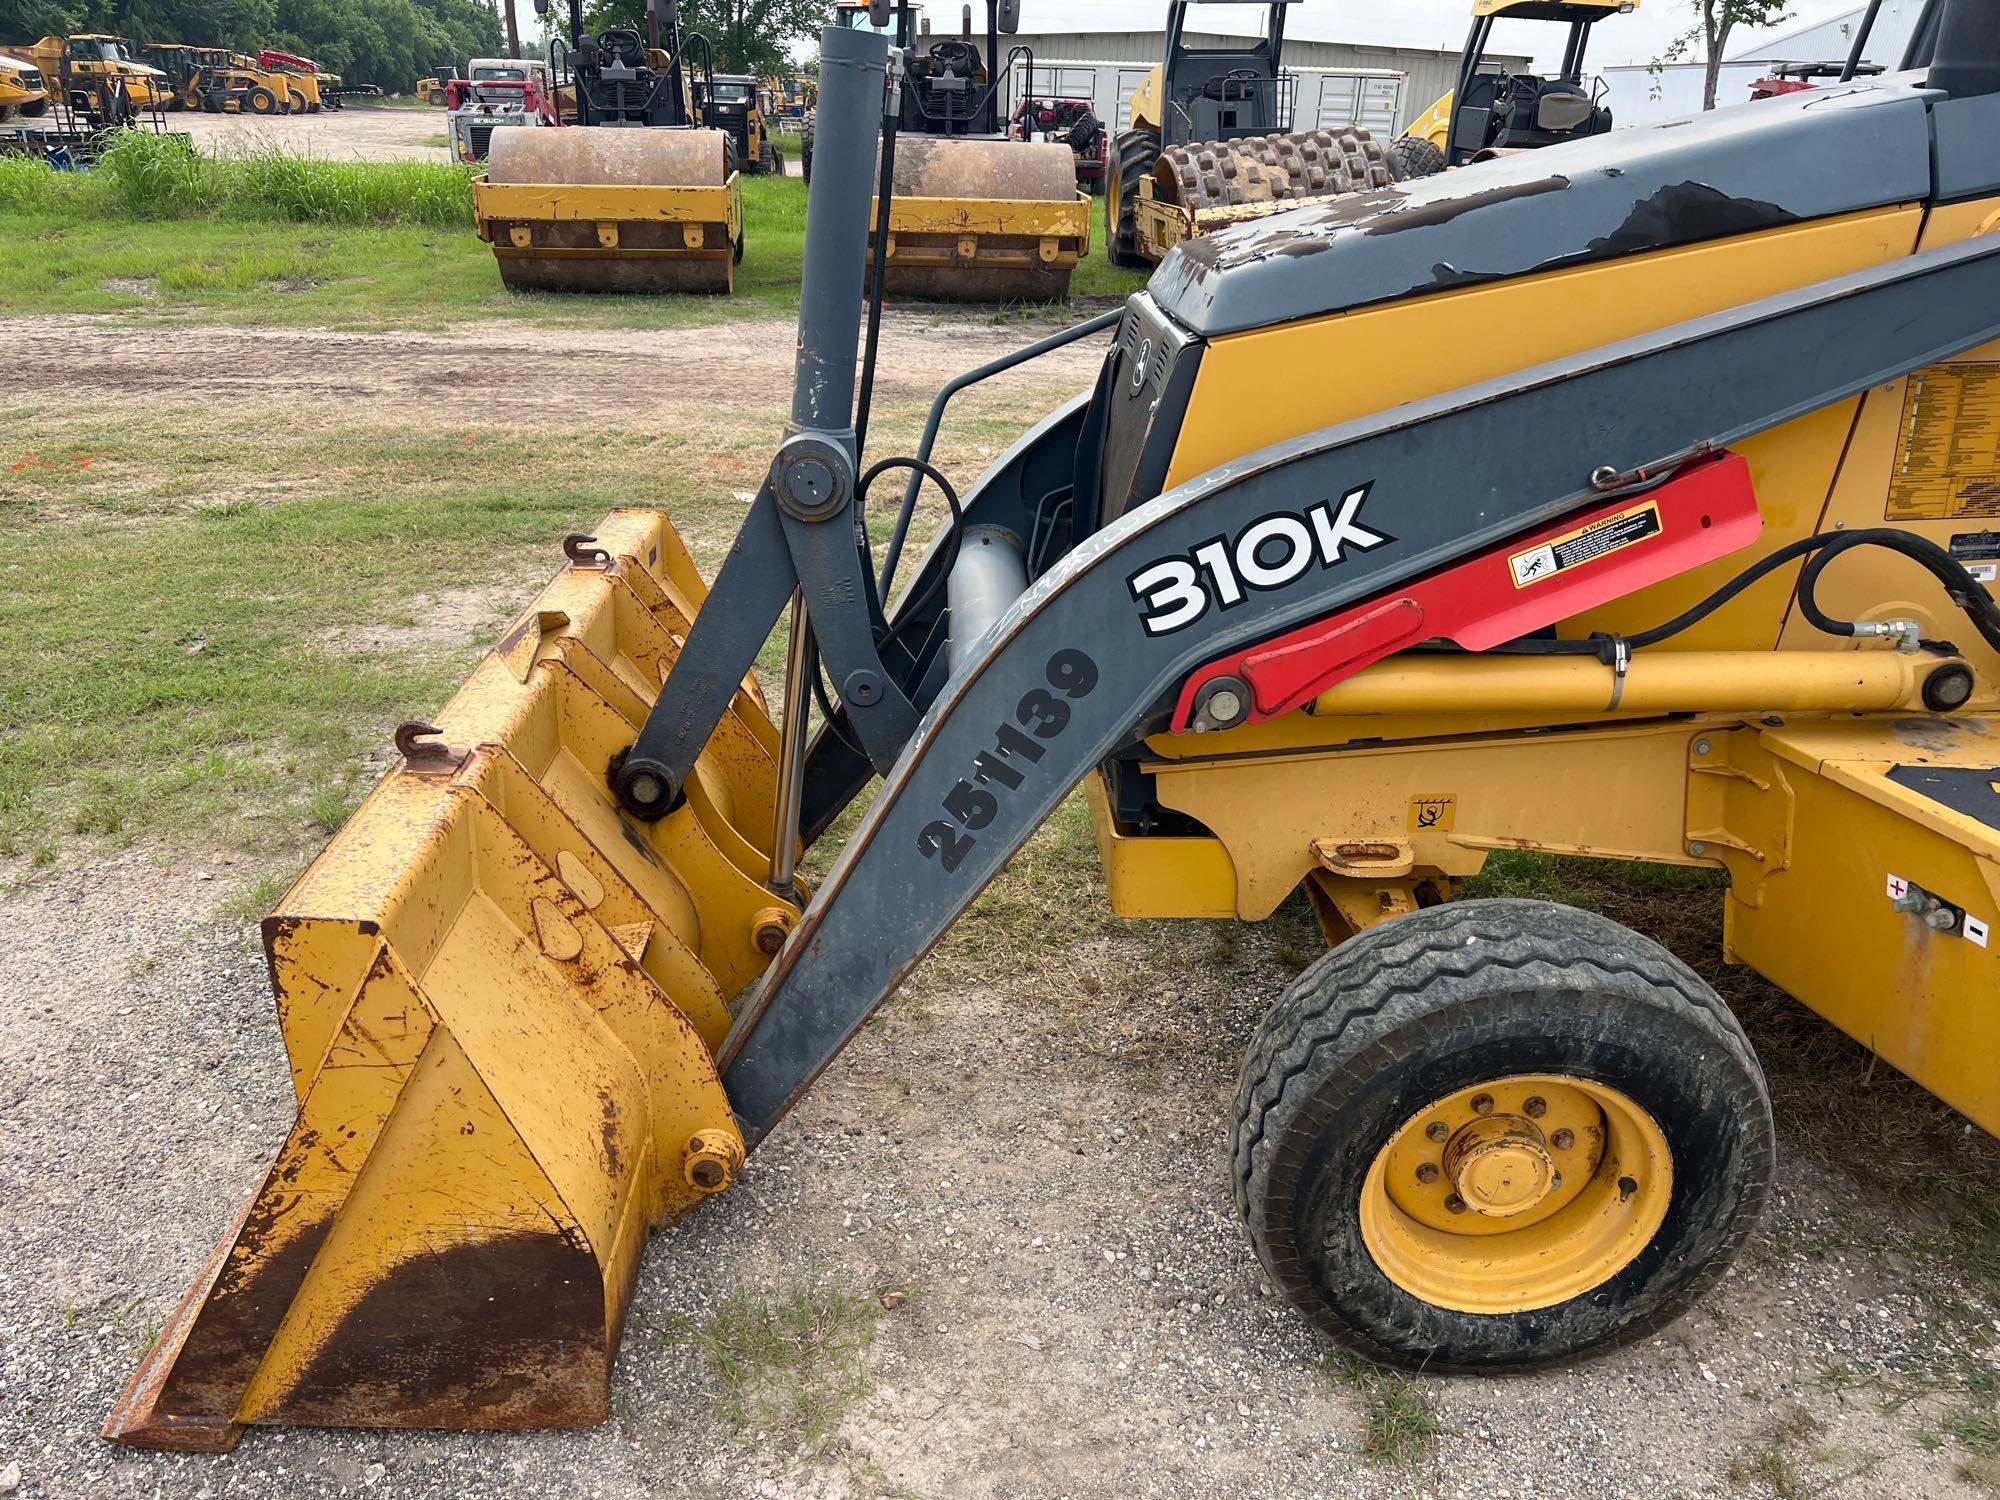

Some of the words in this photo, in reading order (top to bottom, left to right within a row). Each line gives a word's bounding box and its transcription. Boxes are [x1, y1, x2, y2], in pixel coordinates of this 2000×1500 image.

[1129, 483, 1394, 635] 310K
[1589, 513, 1625, 531] WARNING
[917, 648, 1099, 873] 251139
